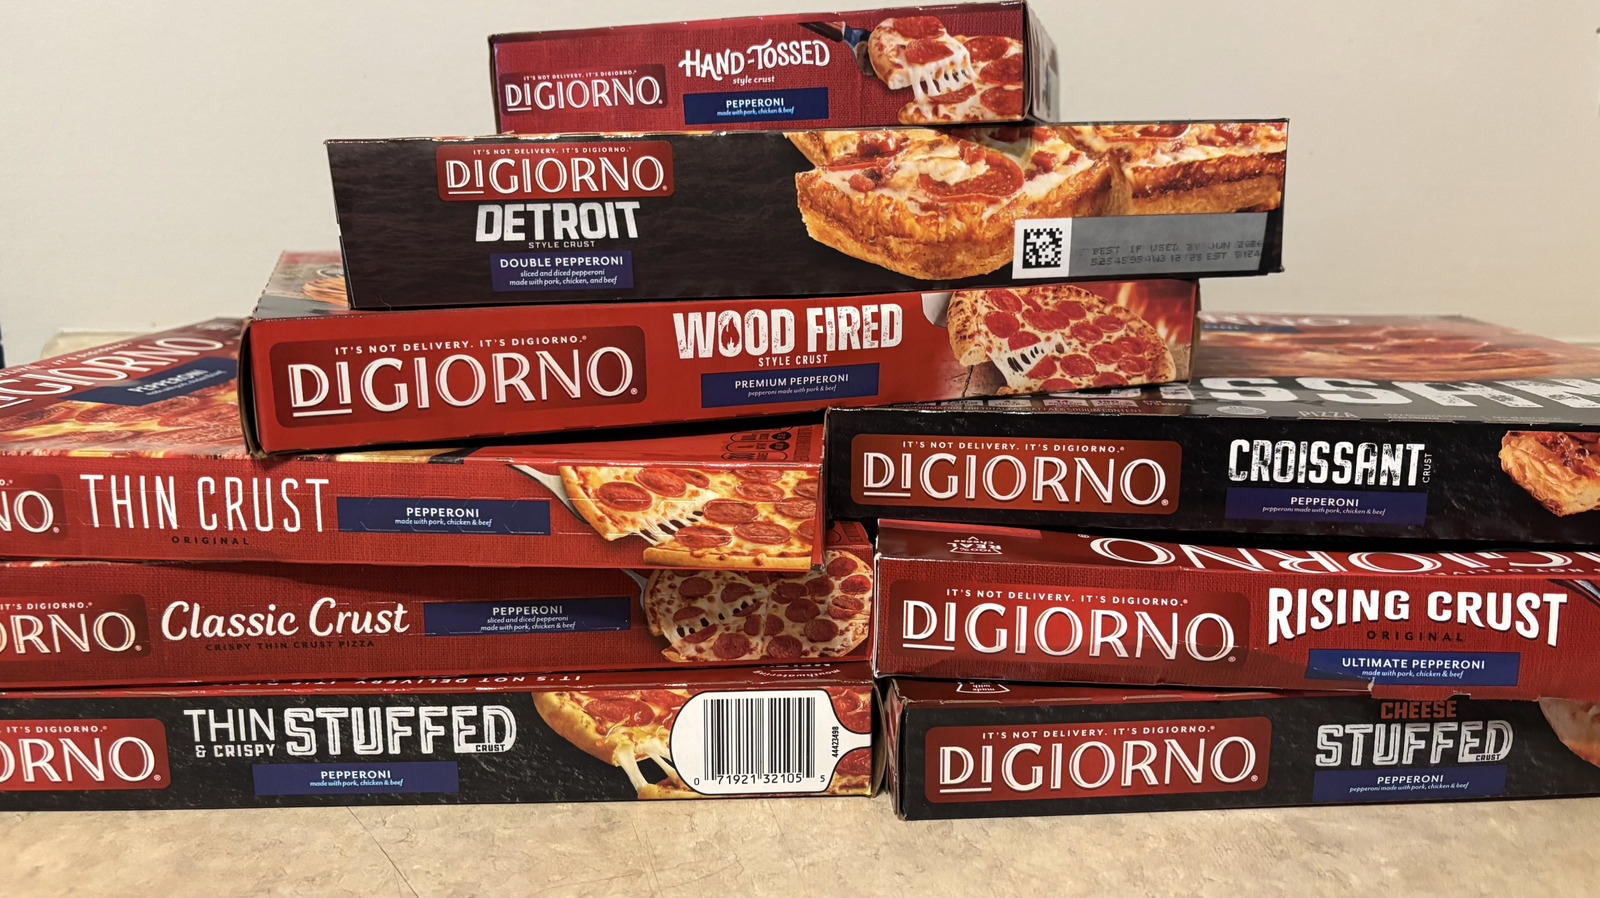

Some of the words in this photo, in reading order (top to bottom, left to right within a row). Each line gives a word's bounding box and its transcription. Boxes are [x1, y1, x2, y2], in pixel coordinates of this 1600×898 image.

[678, 39, 830, 81] HAND-TOSSED
[733, 75, 752, 86] style
[754, 75, 775, 84] crust
[505, 76, 660, 111] DIGIORNO
[726, 98, 785, 108] PEPPERONI
[446, 156, 664, 194] DIGIORNO
[476, 201, 640, 242] DETROIT
[528, 241, 559, 249] STYLE
[563, 240, 595, 248] CRUST
[1093, 246, 1120, 255] BEST
[1130, 245, 1142, 254] IF
[1150, 244, 1179, 253] USED
[1208, 242, 1231, 250] JUN
[500, 258, 552, 268] DOUBLE
[555, 256, 623, 267] PEPPERONI
[572, 269, 605, 278] pepperoni
[509, 278, 528, 286] made
[528, 278, 544, 286] with
[544, 277, 562, 286] pork,
[562, 275, 589, 285] chicken,
[589, 276, 603, 284] and
[603, 275, 618, 285] beef
[672, 308, 795, 360] WOOD
[806, 303, 903, 353] FIRED
[335, 346, 363, 356] IT'S
[369, 344, 397, 353] NOT
[403, 340, 473, 352] DELIVERY.
[480, 339, 506, 348] IT'S
[758, 357, 791, 367] STYLE
[796, 354, 828, 365] CRUST
[0, 338, 224, 402] GIORNO
[288, 346, 634, 418] DIGIORNO
[735, 378, 787, 389] PREMIUM
[790, 374, 849, 386] PEPPERONI
[930, 441, 953, 449] NOT
[959, 442, 1019, 450] DELIVERY.
[1228, 439, 1426, 487] CROISSANT
[1422, 453, 1433, 484] CRUST
[863, 452, 1167, 506] DIGIORNO
[80, 474, 178, 529] THIN
[196, 476, 329, 533] CRUST
[1290, 497, 1359, 507] PEPPERONI
[406, 507, 480, 518] PEPPERONI
[1372, 508, 1386, 517] beef
[428, 518, 446, 526] pork,
[478, 519, 493, 528] beef
[172, 536, 250, 546] ORIGINAL
[947, 589, 971, 597] IT'S
[977, 590, 1003, 598] NOT
[1008, 591, 1075, 602] DELIVERY.
[1081, 595, 1106, 604] IT'S
[0, 602, 22, 611] IT'S
[492, 606, 563, 616] PEPPERONI
[162, 600, 299, 641] Classic
[308, 597, 410, 637] Crust
[487, 616, 504, 624] sliced
[536, 615, 568, 624] pepperoni
[1268, 587, 1410, 645] RISING
[1427, 590, 1568, 648] CRUST
[513, 623, 531, 632] pork,
[531, 622, 555, 630] chicken
[562, 621, 576, 630] beef
[902, 600, 1235, 662] DIGIORNO
[1367, 630, 1464, 642] ORIGINAL
[256, 643, 288, 651] THIN
[338, 640, 375, 649] PIZZA
[1342, 657, 1408, 669] ULTIMATE
[1412, 658, 1485, 670] PEPPERONI
[1362, 669, 1380, 677] made
[1381, 669, 1397, 677] with
[1396, 670, 1415, 678] pork,
[1449, 670, 1464, 679] beef
[1380, 700, 1457, 719] CHEESE
[6, 726, 31, 734] IT'S
[184, 708, 275, 742] THIN
[284, 705, 517, 756] STUFFED
[982, 732, 1007, 740] IT'S
[1013, 731, 1038, 739] NOT
[1043, 729, 1107, 738] DELIVERY.
[1113, 727, 1137, 736] IT'S
[475, 744, 506, 752] CRUST
[832, 726, 840, 758] 44423498
[1316, 720, 1514, 767] STUFFED
[196, 744, 207, 758] &
[214, 744, 275, 758] CRISPY
[940, 736, 1256, 793] DIGIORNO
[320, 770, 391, 779] PEPPERONI
[694, 778, 700, 786] 0
[717, 774, 757, 785] 71921
[763, 773, 802, 784] 32105
[820, 774, 826, 783] 5
[1377, 774, 1444, 785] PEPPERONI
[310, 779, 328, 787] made
[342, 779, 359, 788] pork,
[390, 778, 404, 787] beef
[1411, 783, 1427, 791] pork,
[1456, 781, 1470, 790] beef
